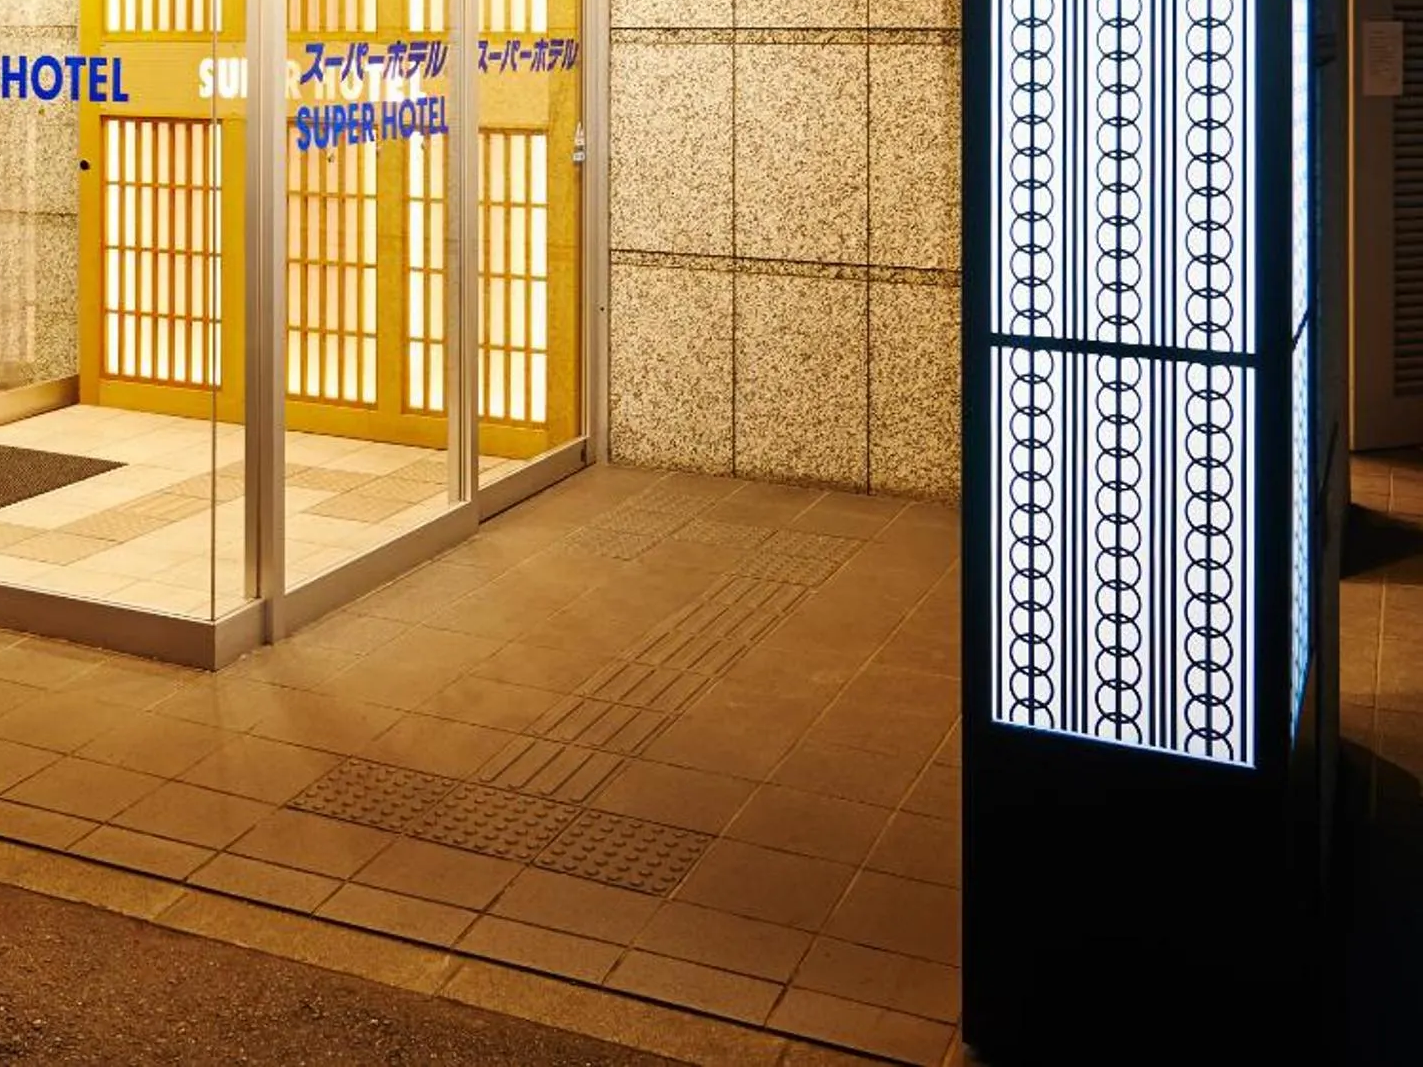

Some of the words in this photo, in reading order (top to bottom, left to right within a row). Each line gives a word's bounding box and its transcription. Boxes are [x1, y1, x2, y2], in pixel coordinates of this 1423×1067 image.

[1, 54, 129, 102] HOTEL
[198, 57, 302, 100] SUR
[300, 40, 449, 84] スーパーホテル
[296, 100, 376, 151] SUPER
[381, 95, 449, 140] HOTEL
